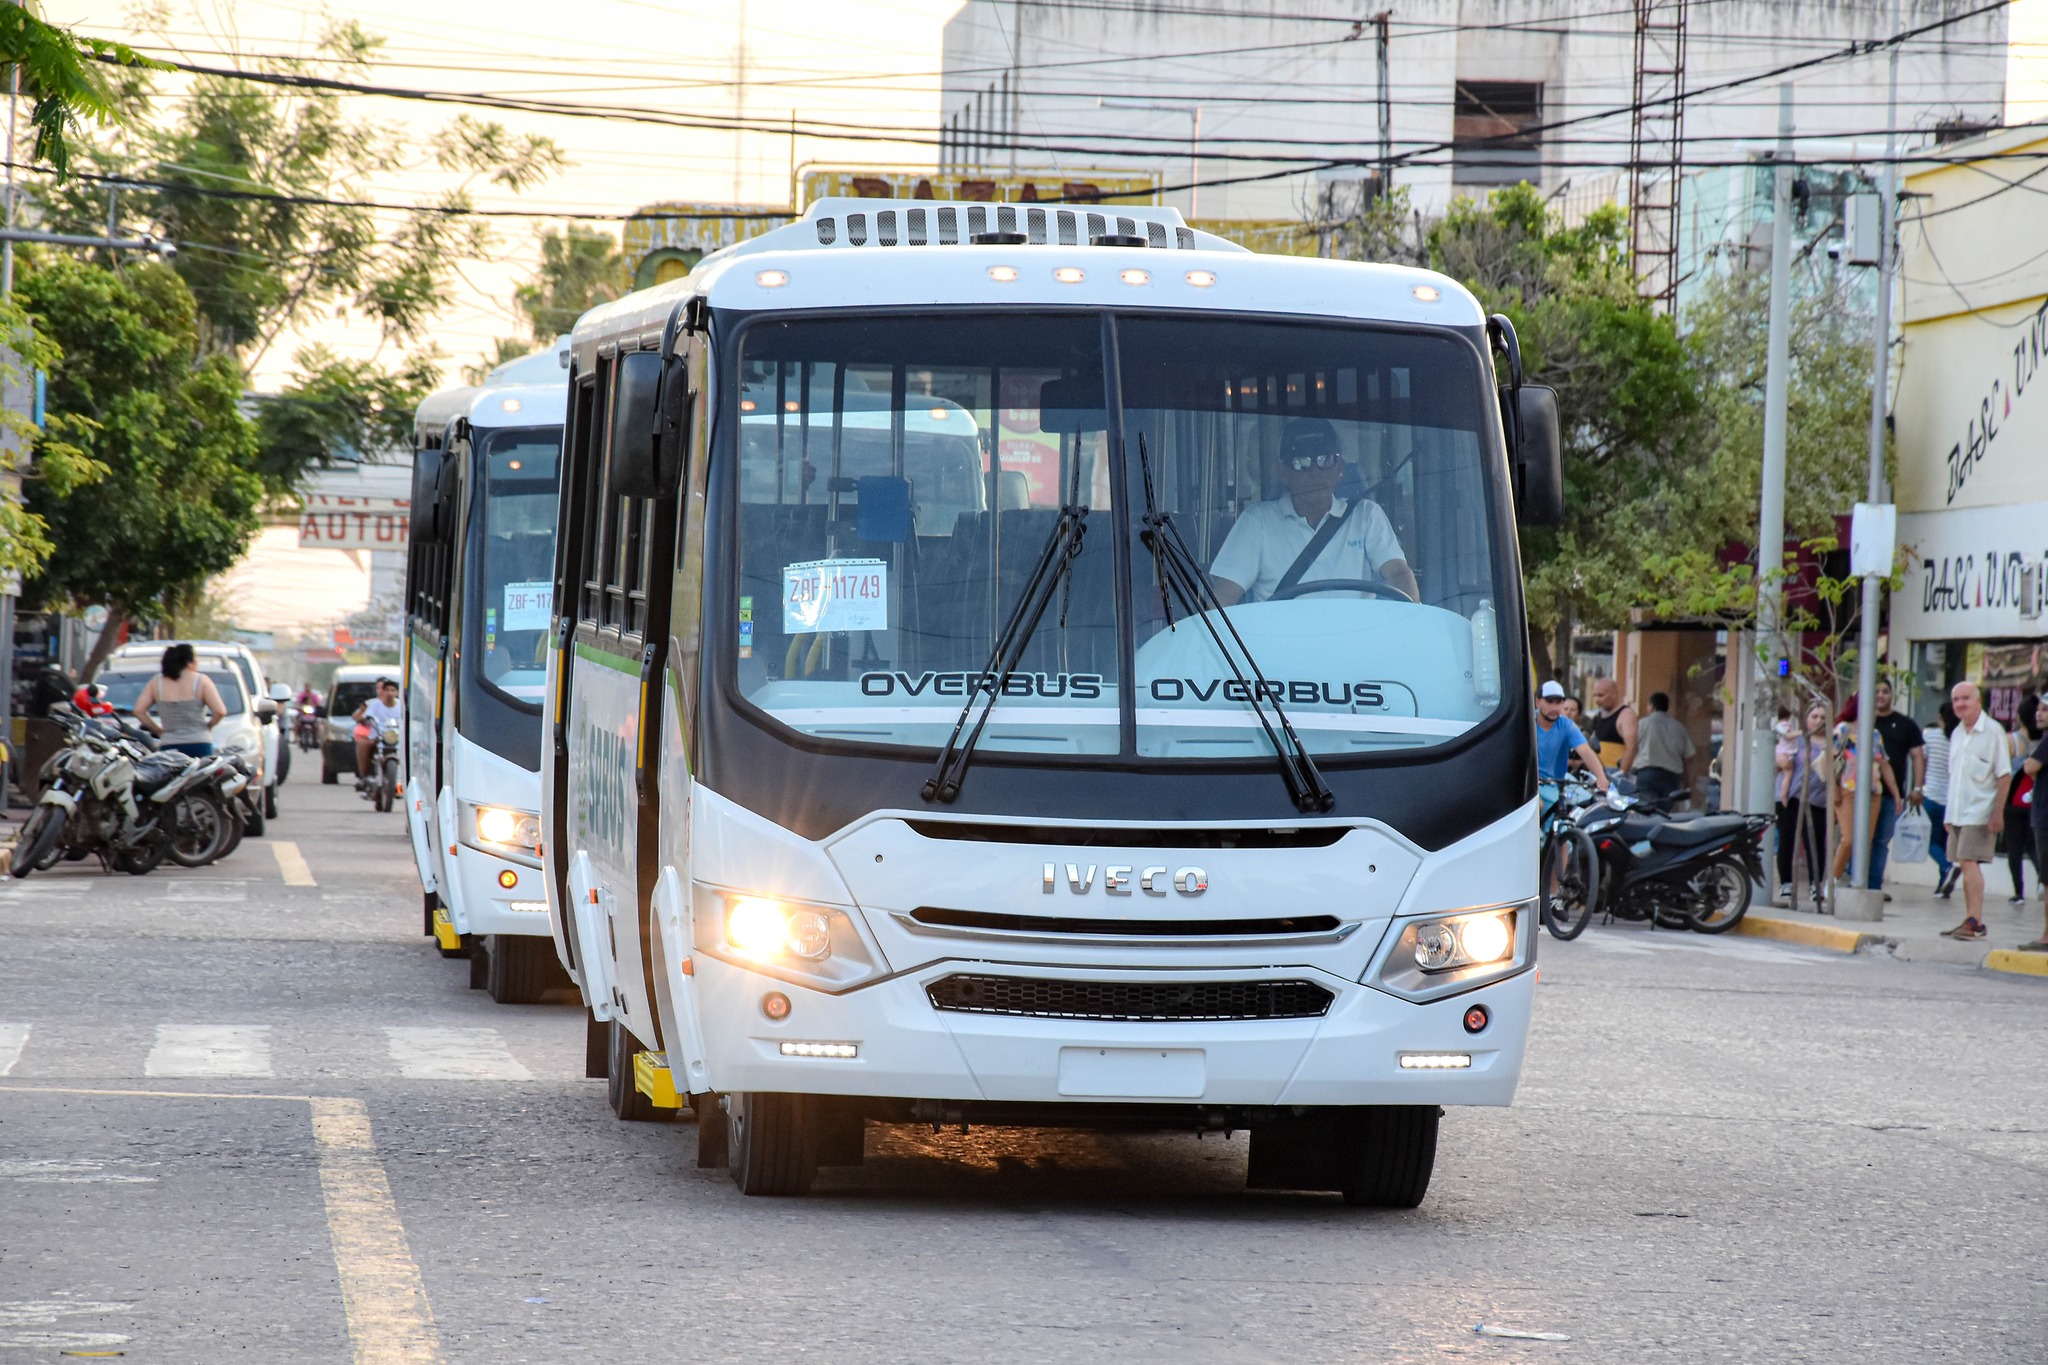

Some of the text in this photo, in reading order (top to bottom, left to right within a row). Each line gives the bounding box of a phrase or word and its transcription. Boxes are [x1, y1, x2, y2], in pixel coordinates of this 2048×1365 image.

[860, 672, 1101, 700] OVERBUS
[1150, 678, 1385, 706] OVERBUS
[1043, 862, 1209, 899] IVECO
